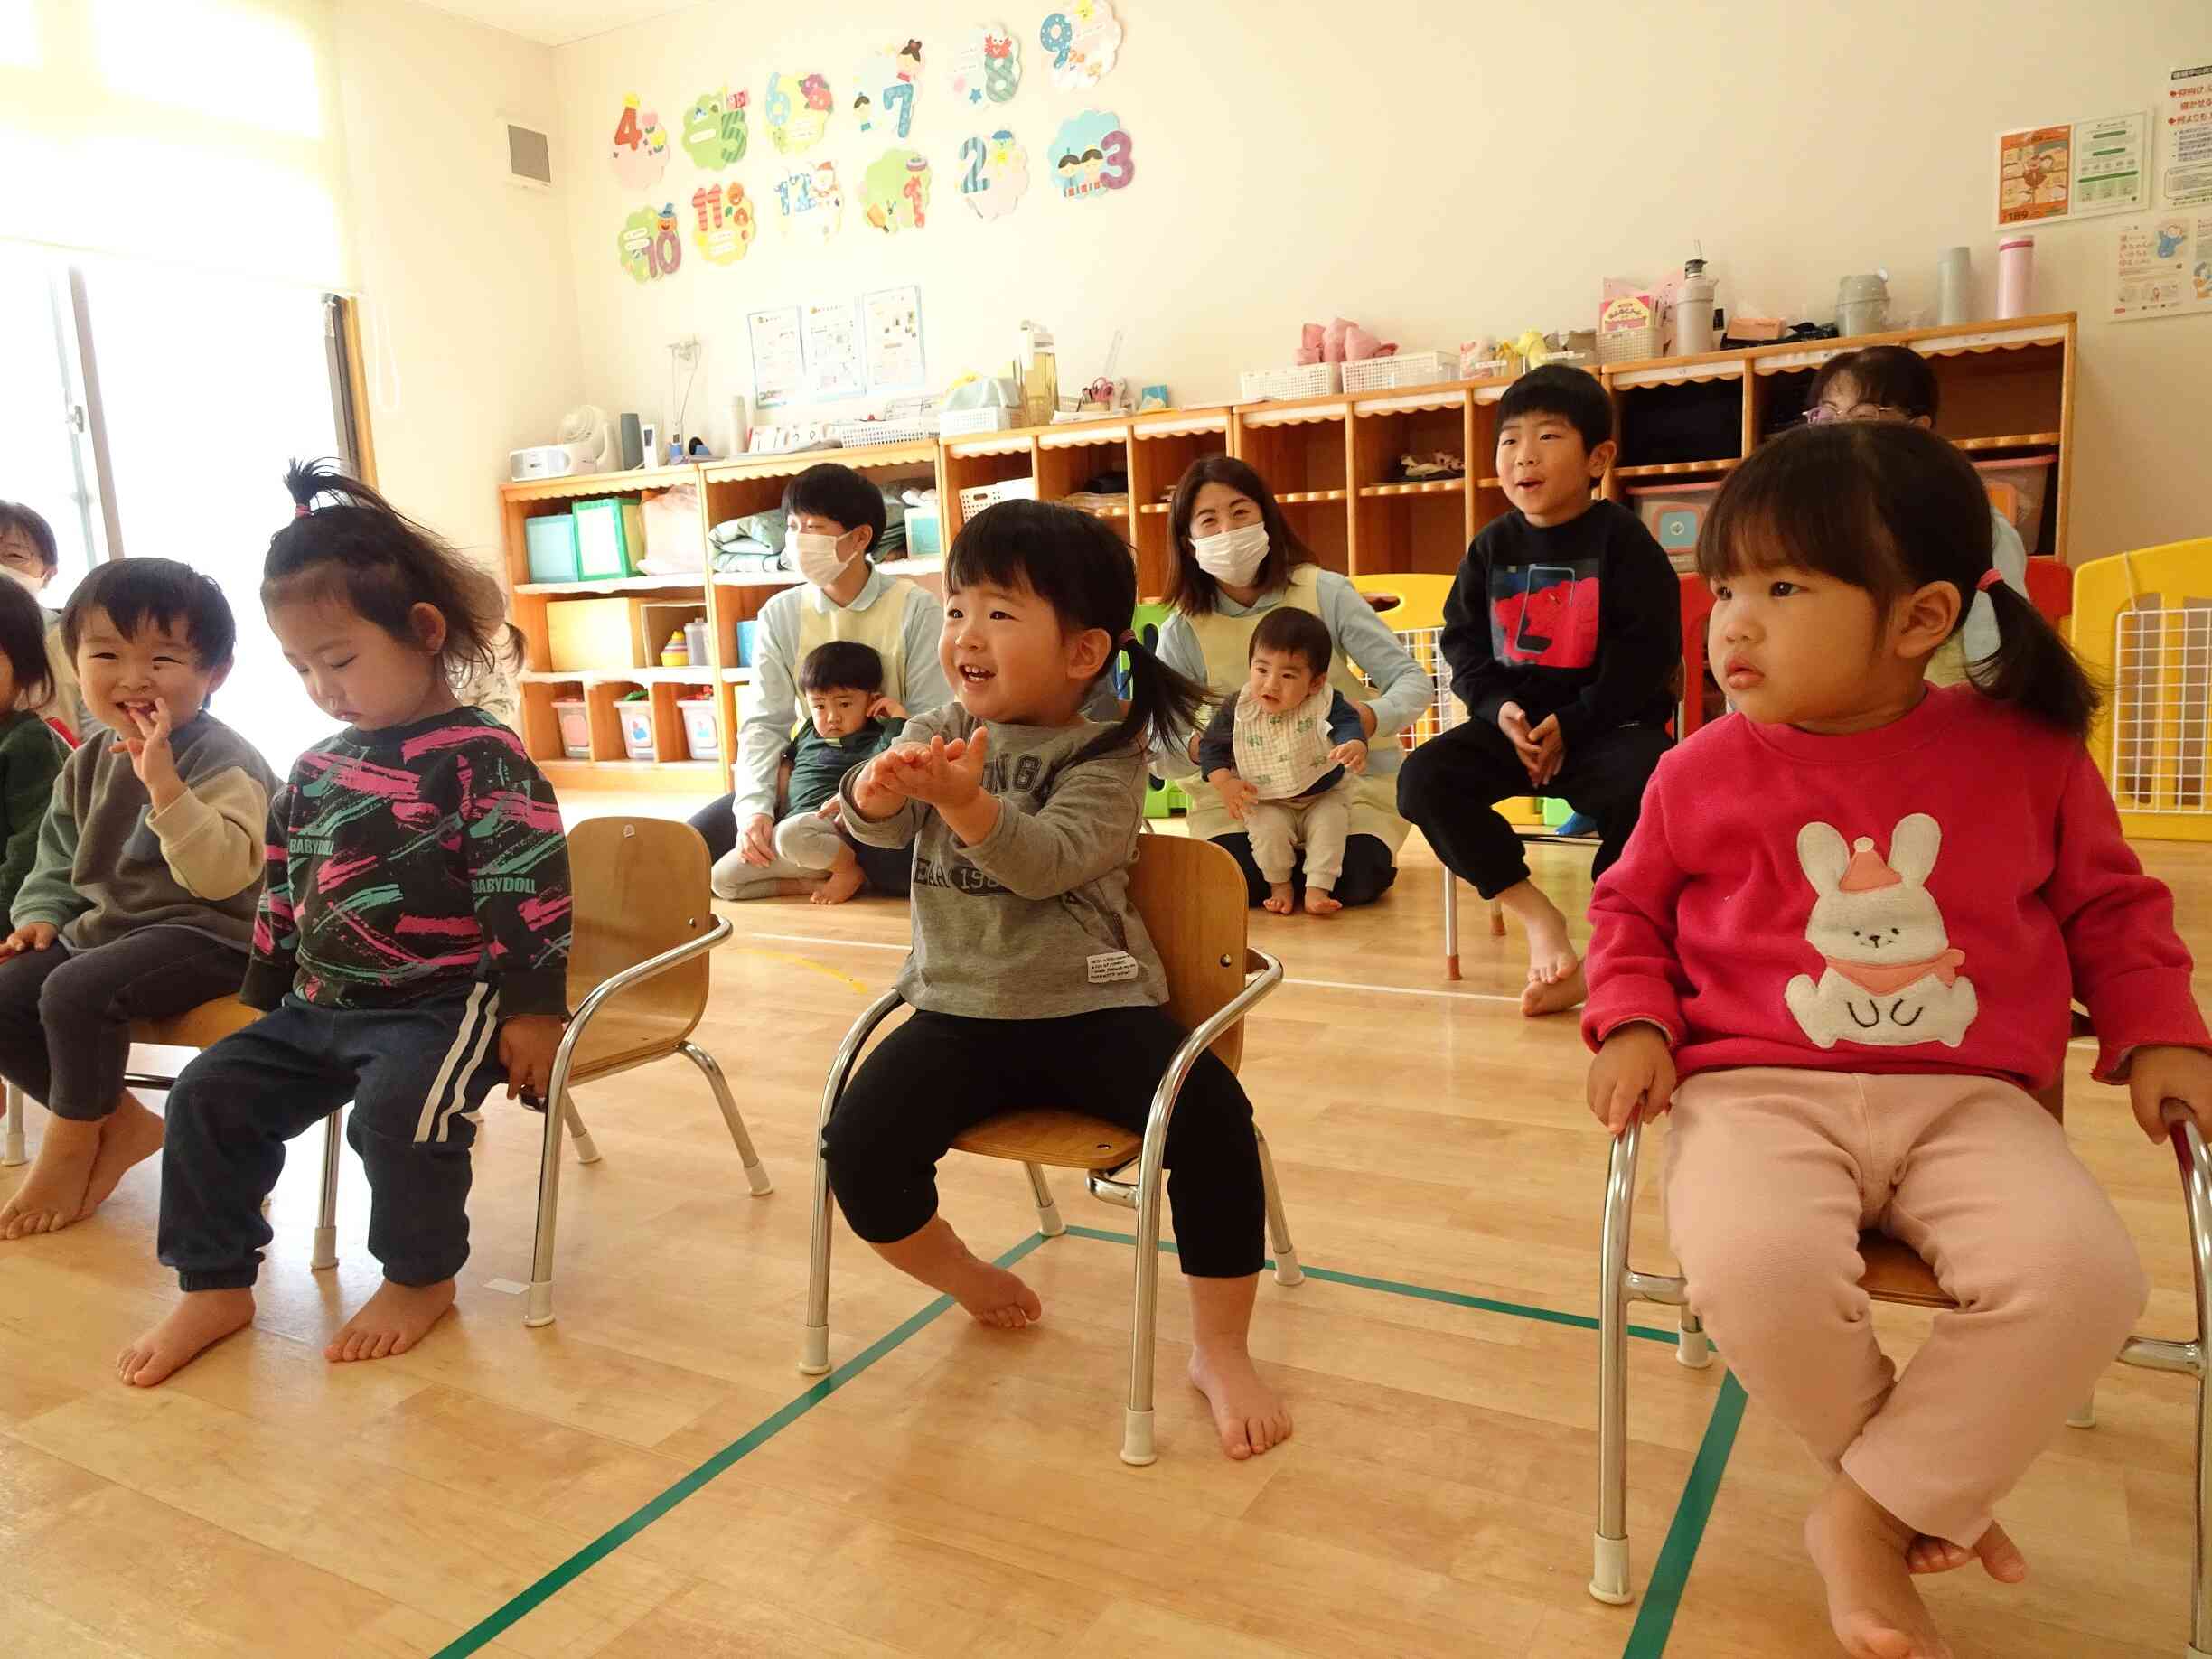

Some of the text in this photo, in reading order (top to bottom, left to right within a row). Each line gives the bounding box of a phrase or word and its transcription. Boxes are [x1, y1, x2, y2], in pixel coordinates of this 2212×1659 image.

[1040, 13, 1073, 69] 9
[764, 71, 791, 126] 6
[984, 54, 1016, 103] 8
[614, 106, 642, 151] 4
[721, 109, 748, 163] 5
[883, 83, 914, 138] 7
[960, 136, 990, 194] 2
[1099, 130, 1135, 190] 3
[692, 183, 723, 233] 11
[773, 172, 818, 217] 12
[902, 174, 926, 230] 1
[642, 230, 682, 279] 10
[472, 877, 536, 894] BABYDOLL
